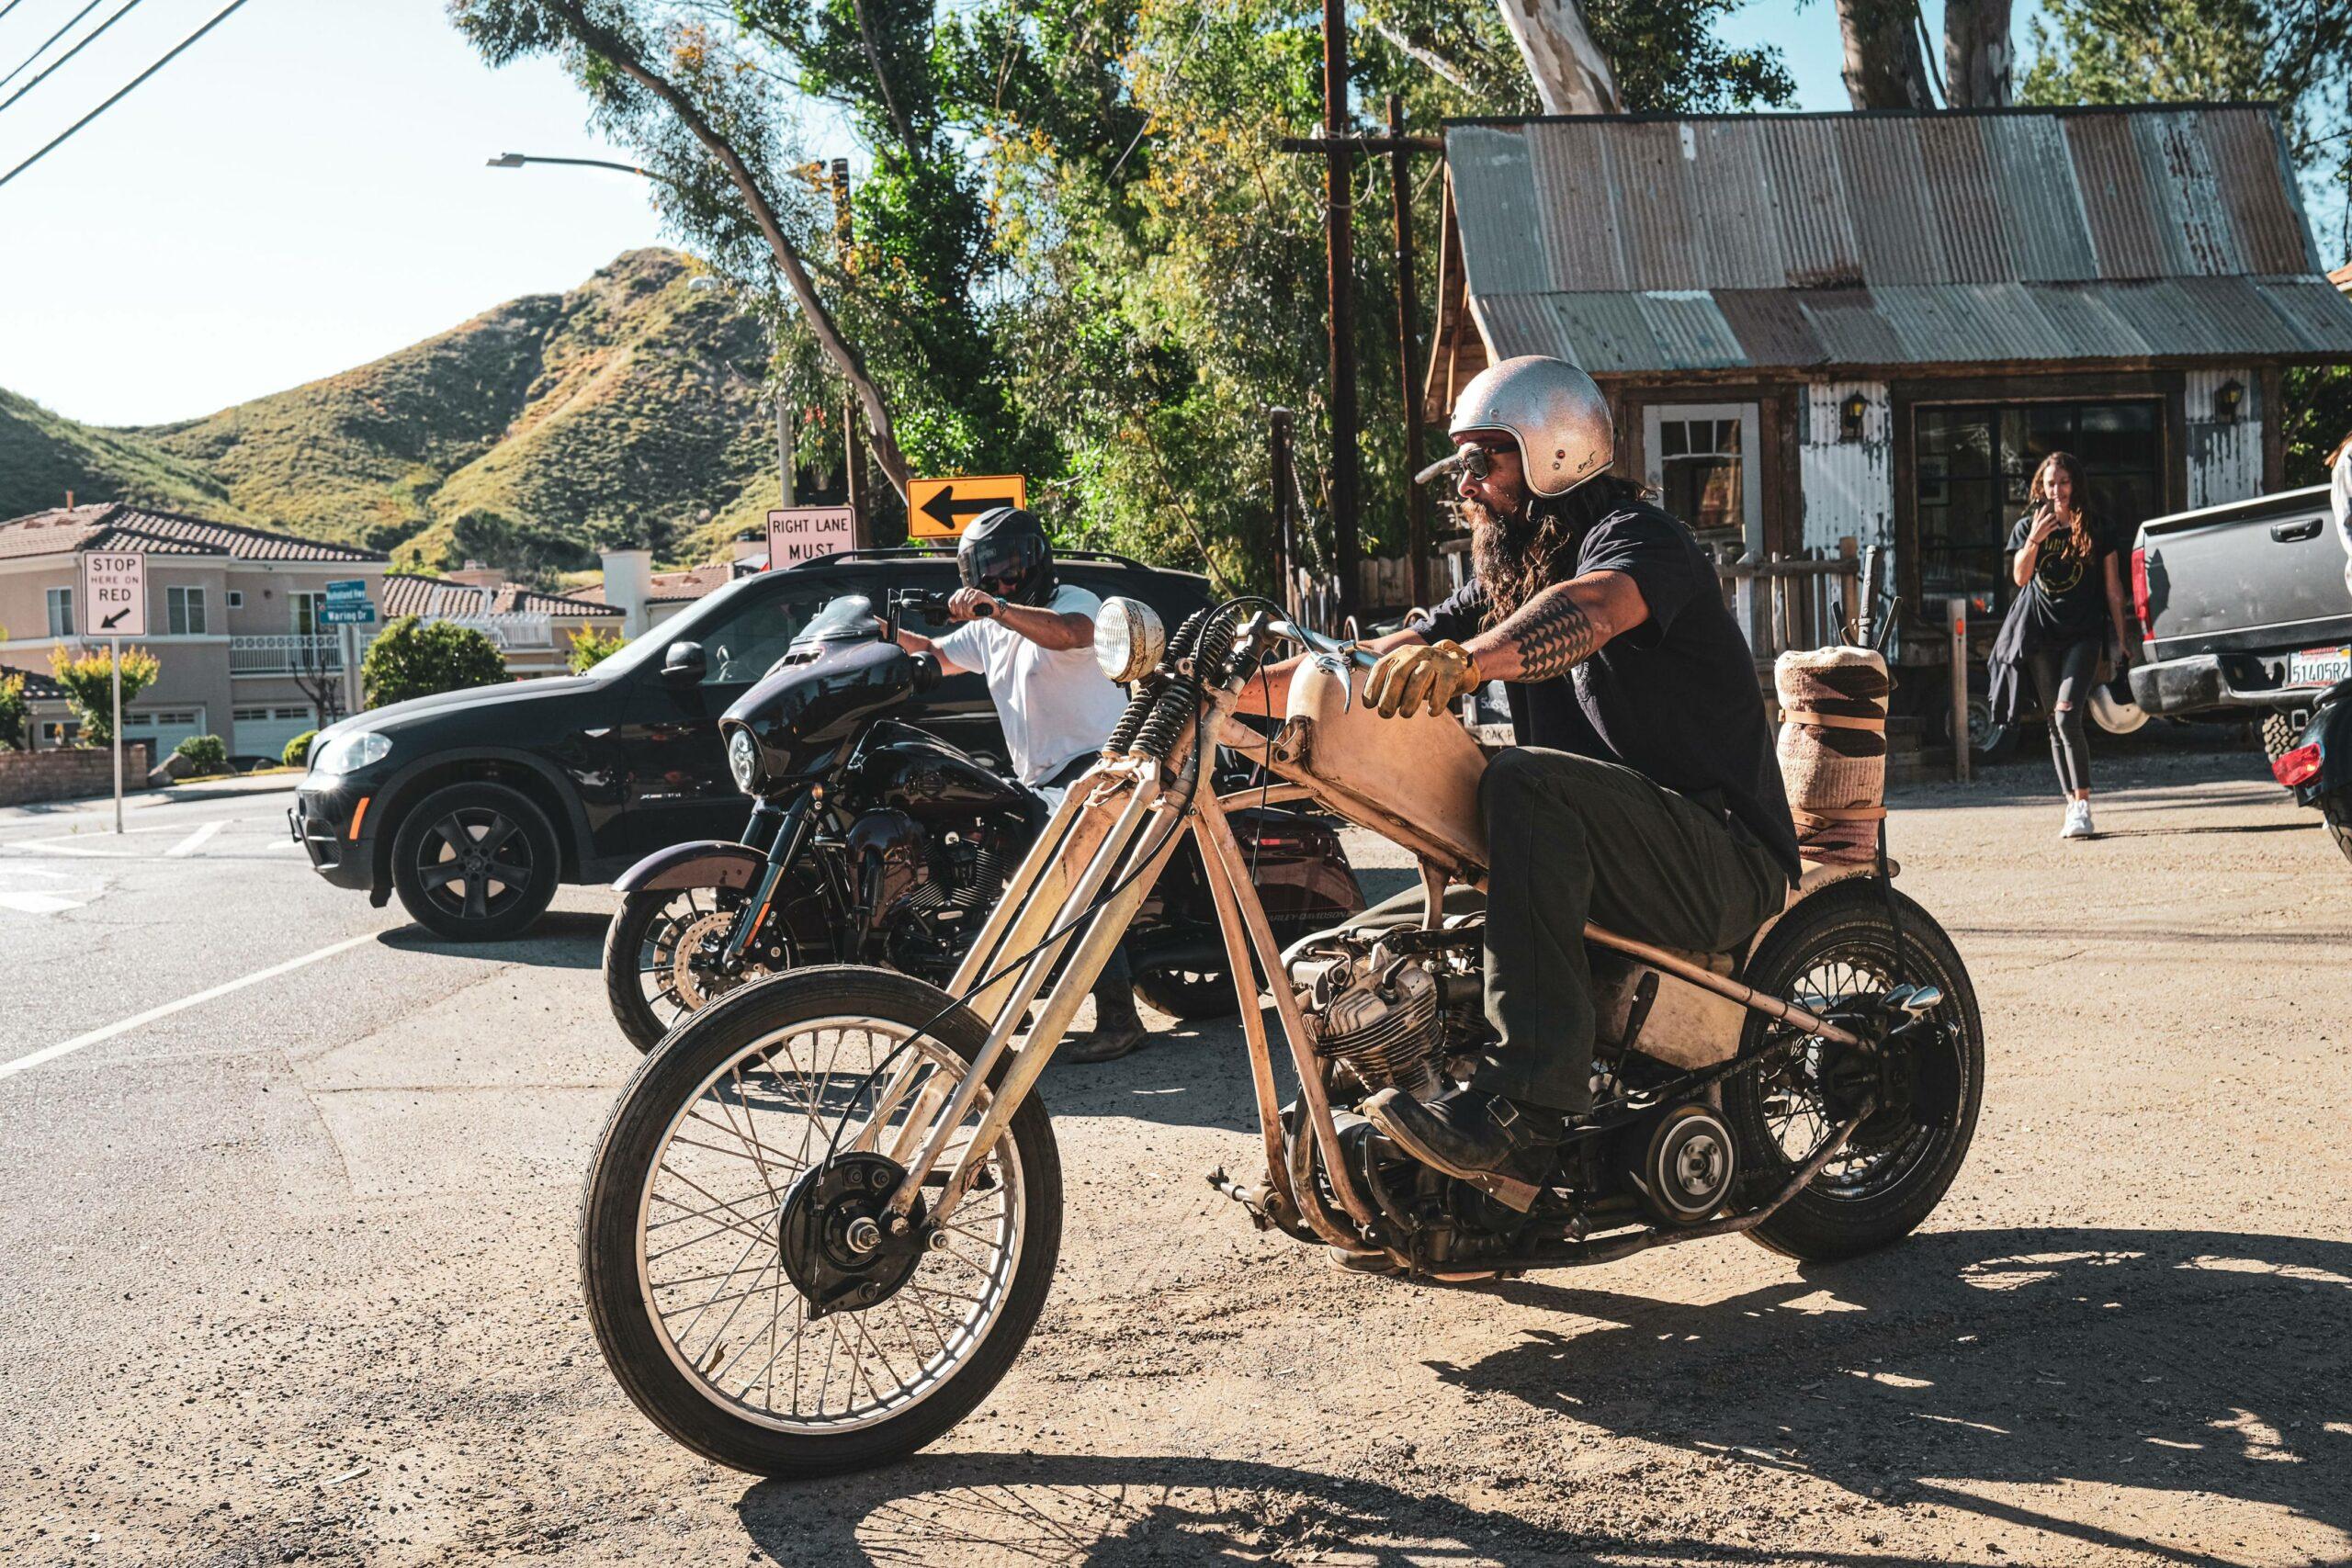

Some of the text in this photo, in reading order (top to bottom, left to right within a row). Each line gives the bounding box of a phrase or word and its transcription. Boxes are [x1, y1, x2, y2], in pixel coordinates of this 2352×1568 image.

[773, 518, 848, 533] RIGHT LANE
[789, 543, 834, 559] MUST
[93, 558, 136, 571] STOP
[91, 575, 139, 584] HERE ON
[99, 588, 131, 602] RED
[327, 610, 367, 622] Waring Dr
[1485, 728, 1504, 741] OAK
